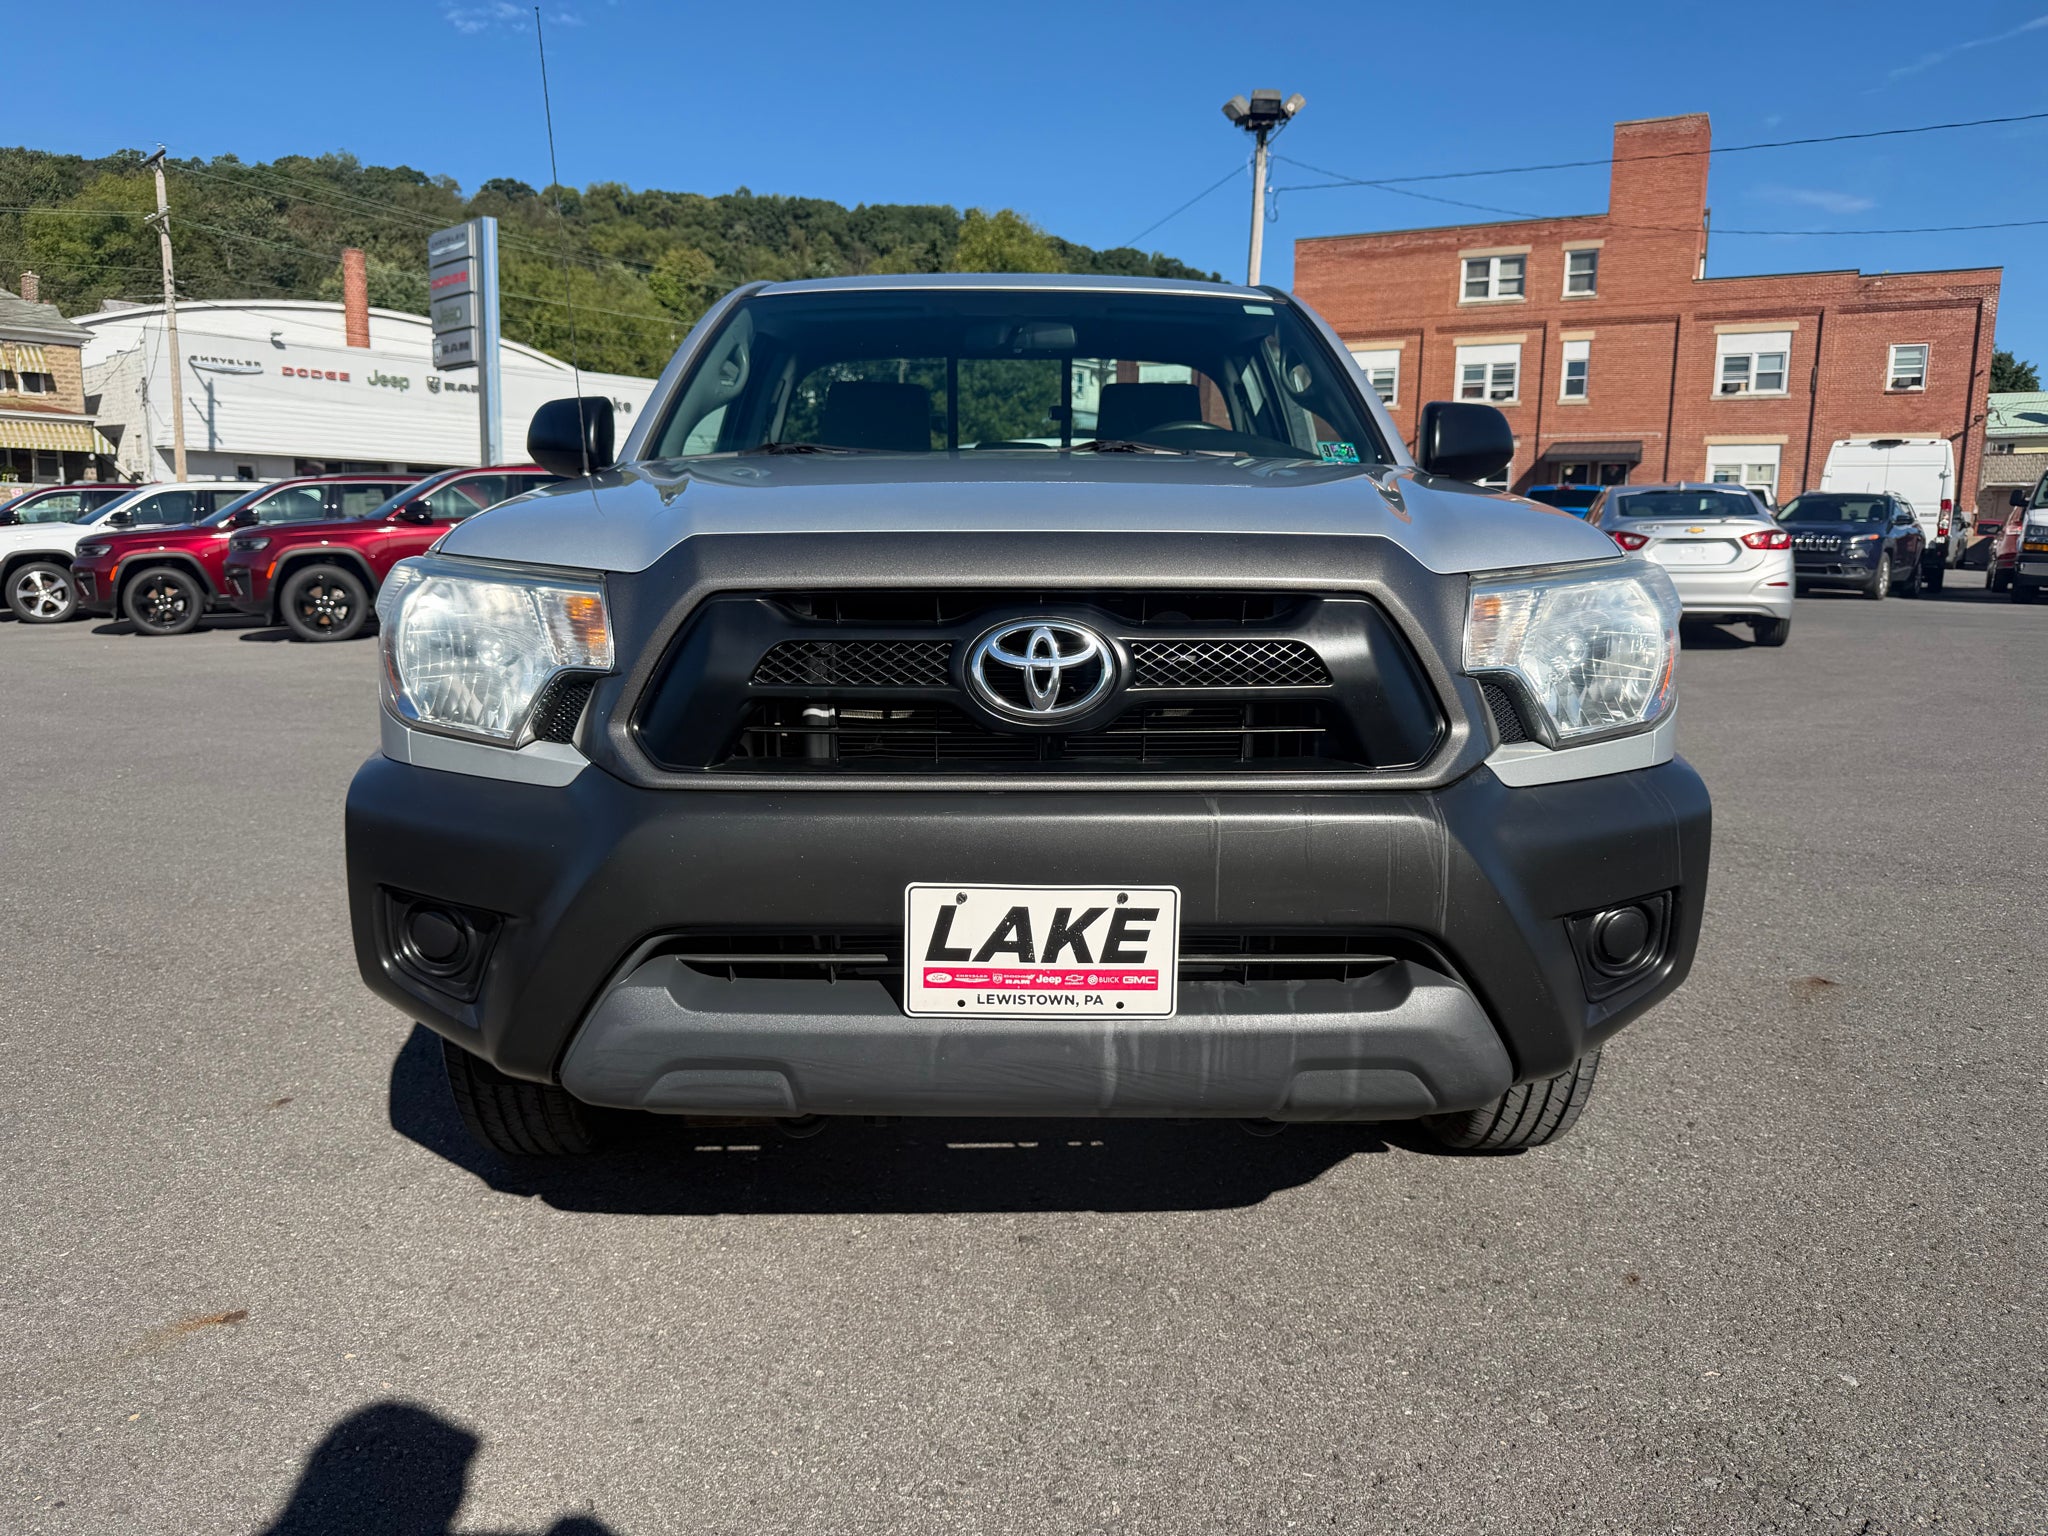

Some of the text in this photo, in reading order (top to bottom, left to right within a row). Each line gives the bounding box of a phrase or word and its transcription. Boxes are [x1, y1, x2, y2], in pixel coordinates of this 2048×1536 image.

[431, 270, 468, 290] DODGE
[442, 341, 470, 356] RAM
[189, 355, 262, 367] CHRYSLER
[281, 366, 351, 382] DODGE
[367, 369, 411, 392] Jeep
[925, 905, 1160, 963] LAKE
[1036, 974, 1062, 985] Jeep
[1122, 976, 1156, 984] GMC
[976, 993, 1104, 1008] LEWISTOWN, PA
